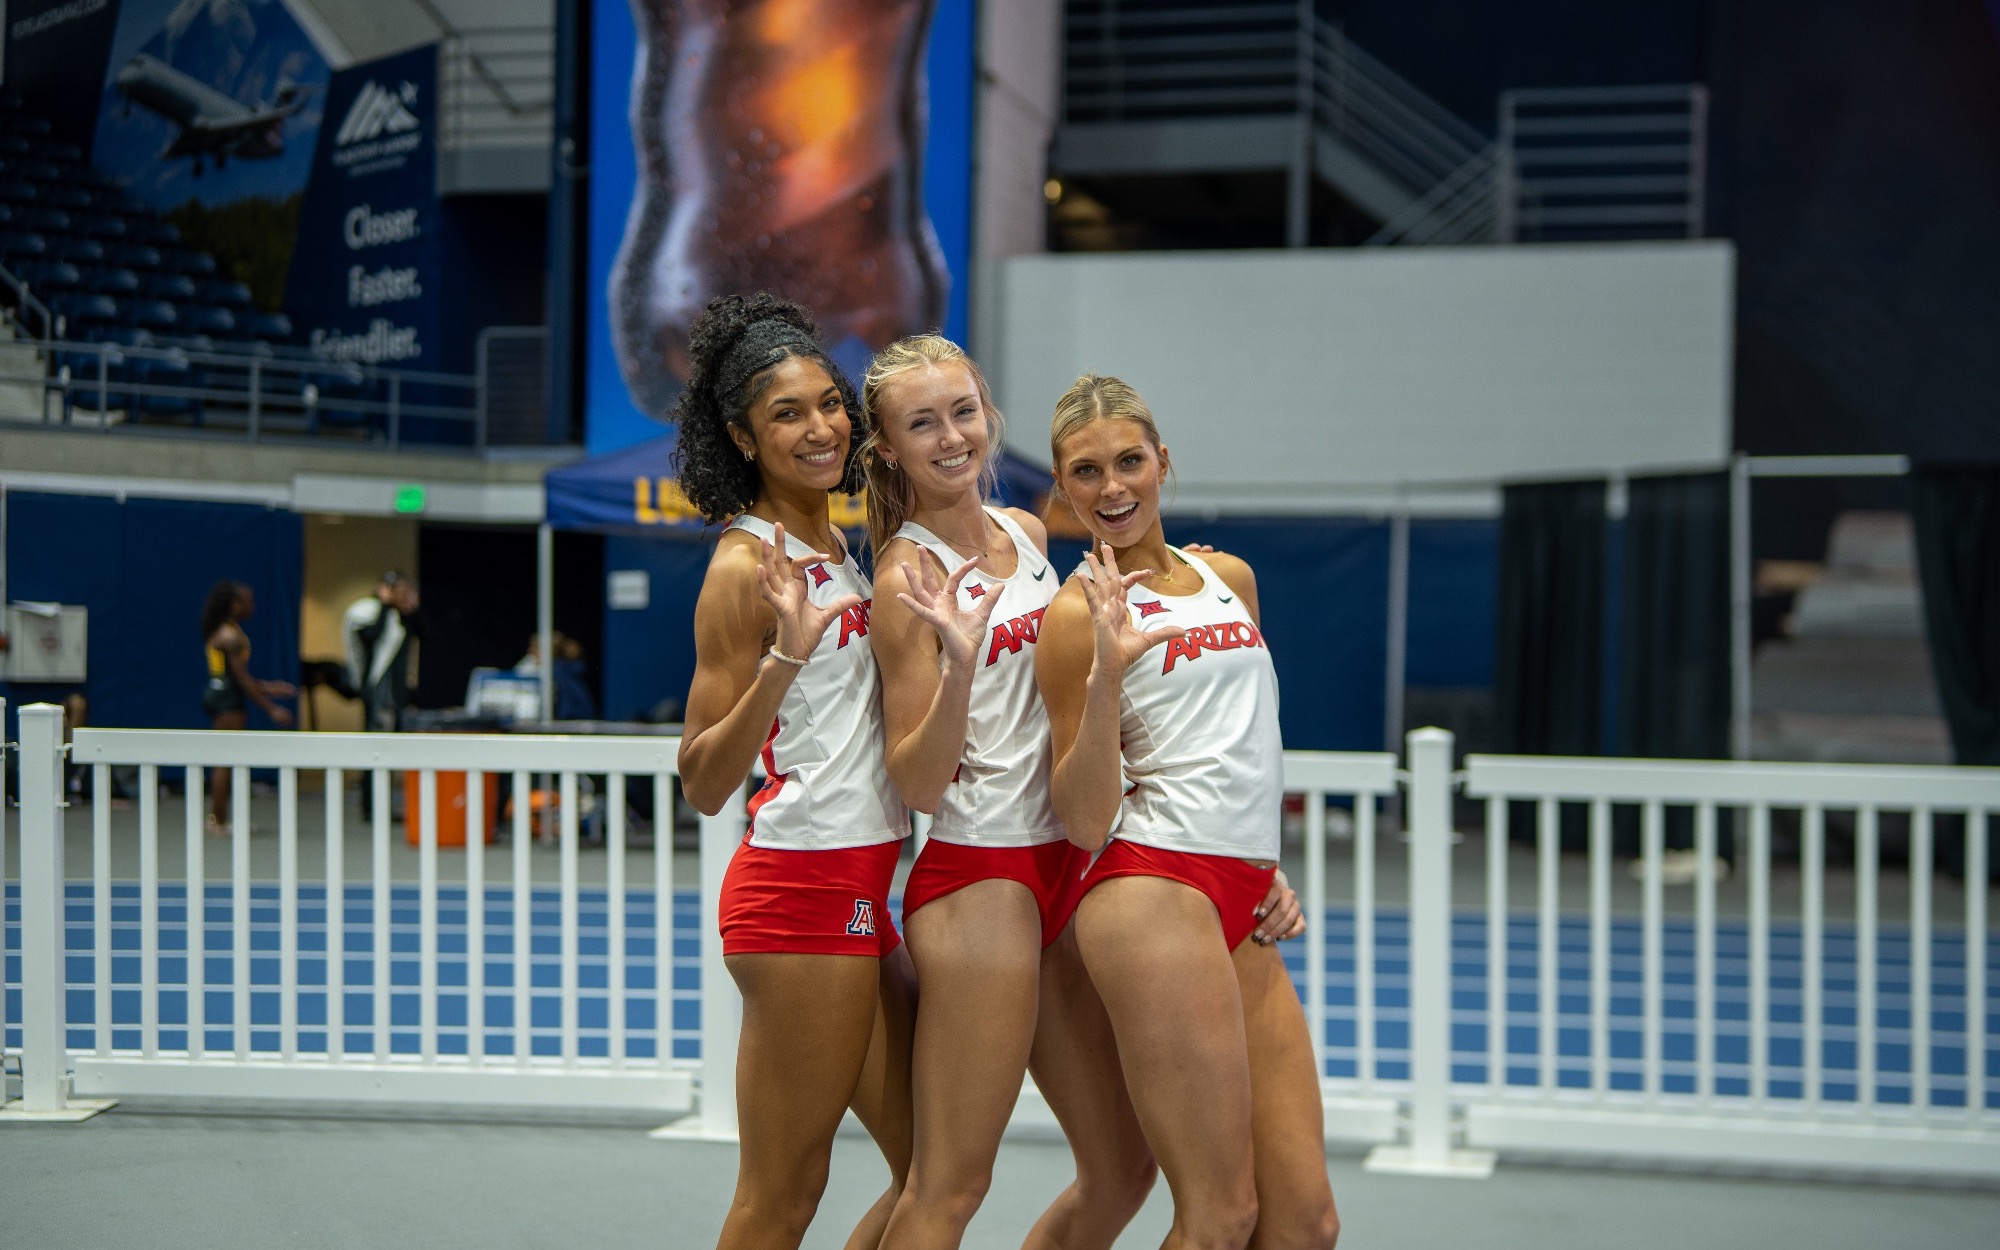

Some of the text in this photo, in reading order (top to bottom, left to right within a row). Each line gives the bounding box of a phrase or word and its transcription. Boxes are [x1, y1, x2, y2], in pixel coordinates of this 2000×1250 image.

[344, 204, 421, 249] Closer.
[348, 265, 422, 307] Faster.
[1132, 600, 1173, 619] XII
[985, 604, 1049, 668] ARIZ
[846, 899, 875, 936] A
